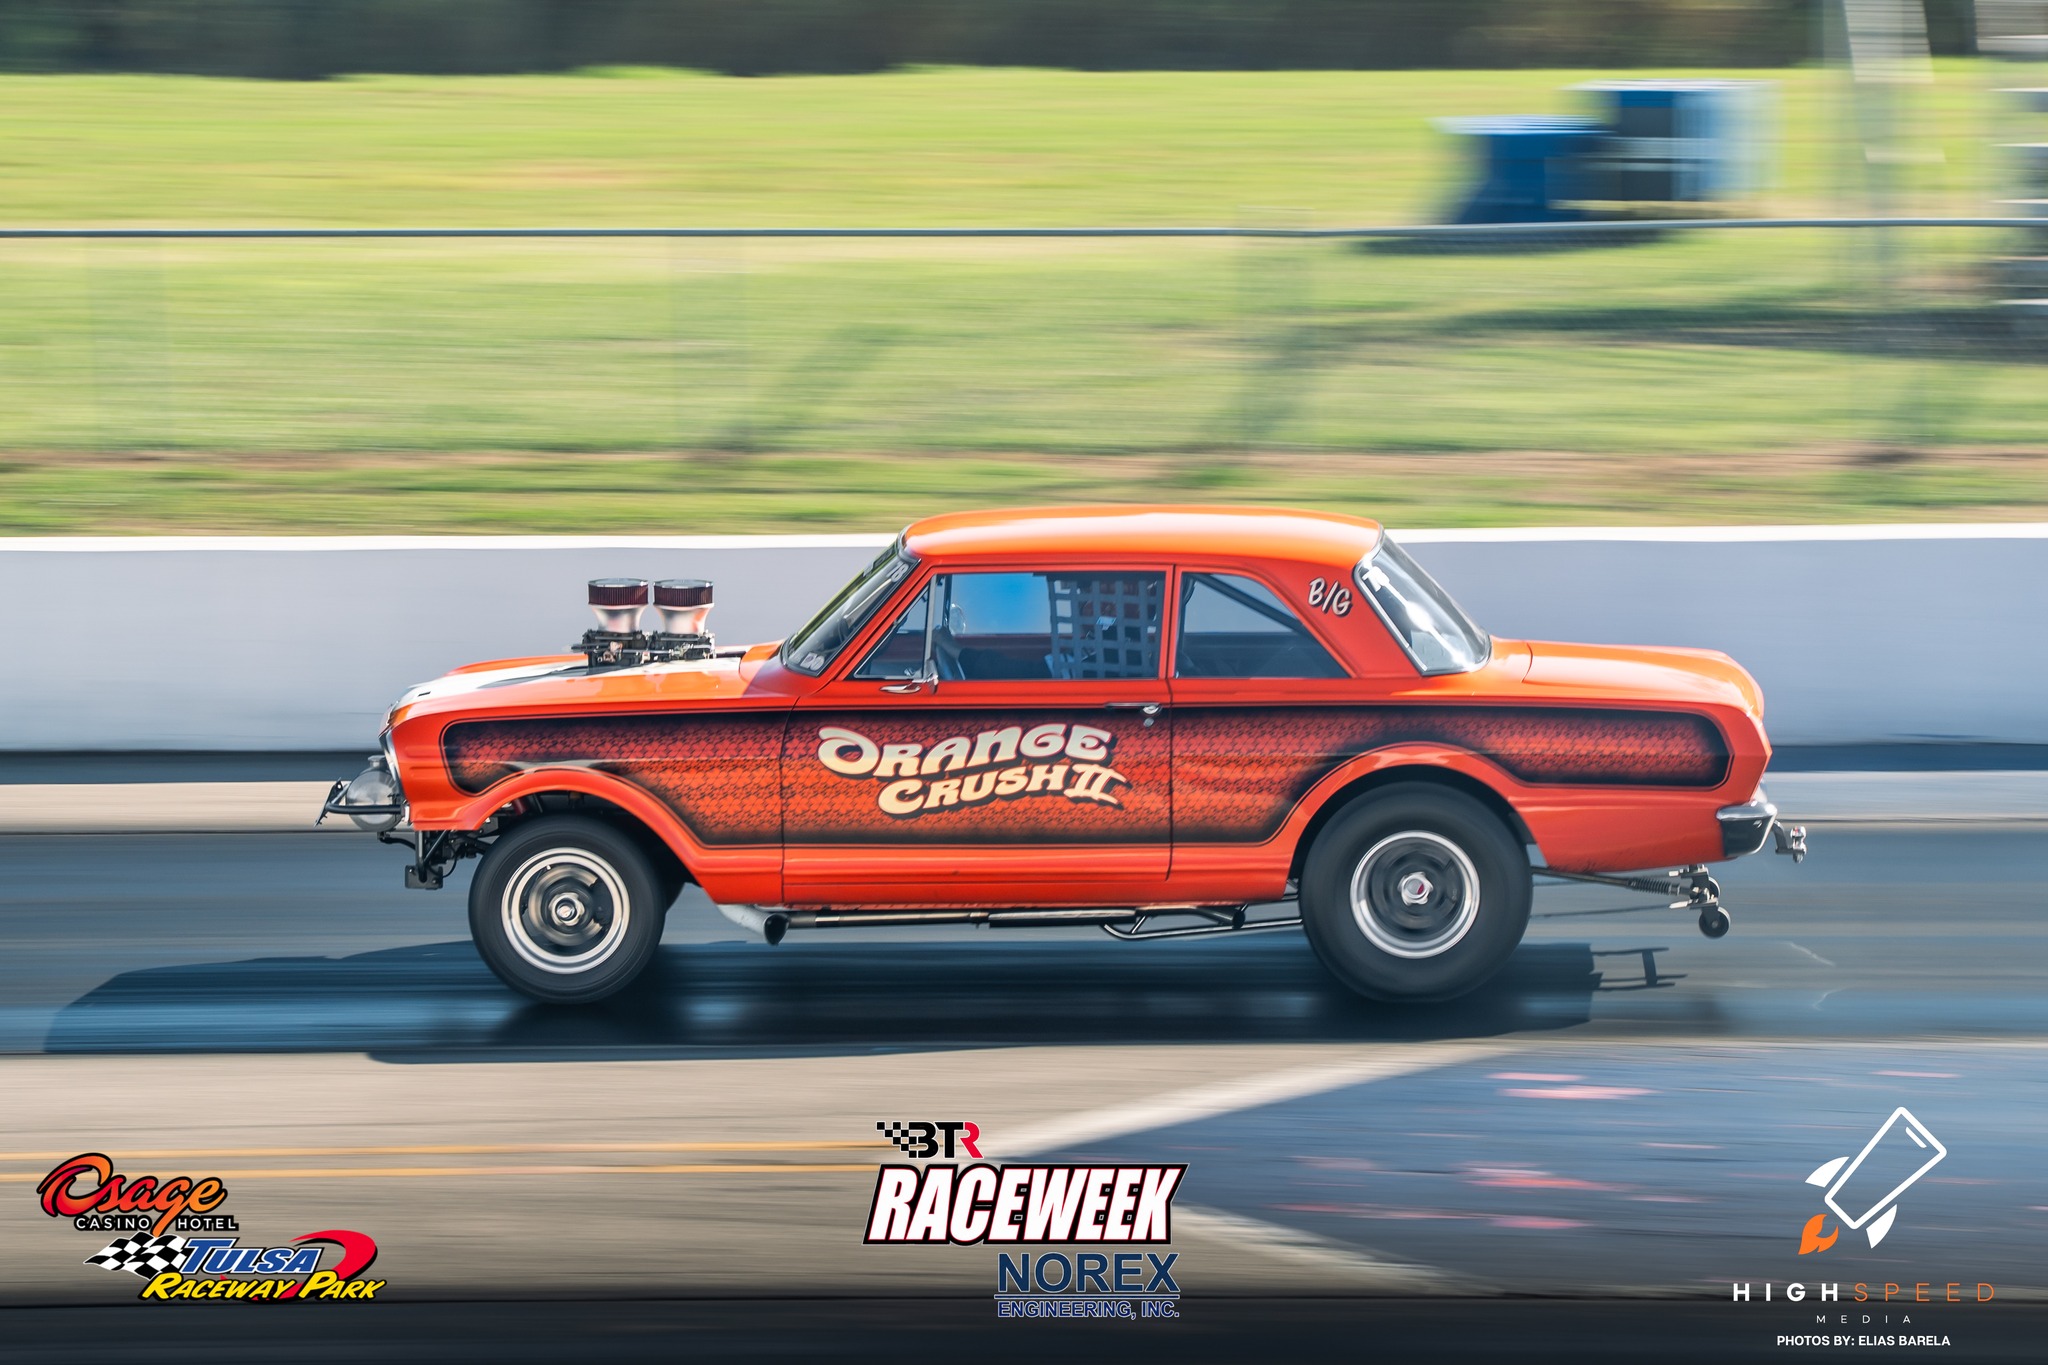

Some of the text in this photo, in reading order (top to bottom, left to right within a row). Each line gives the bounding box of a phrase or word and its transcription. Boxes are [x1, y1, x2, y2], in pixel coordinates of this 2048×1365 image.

[1308, 577, 1352, 616] B/G
[818, 723, 1112, 777] ORANGE
[878, 763, 1129, 815] CRUSH II
